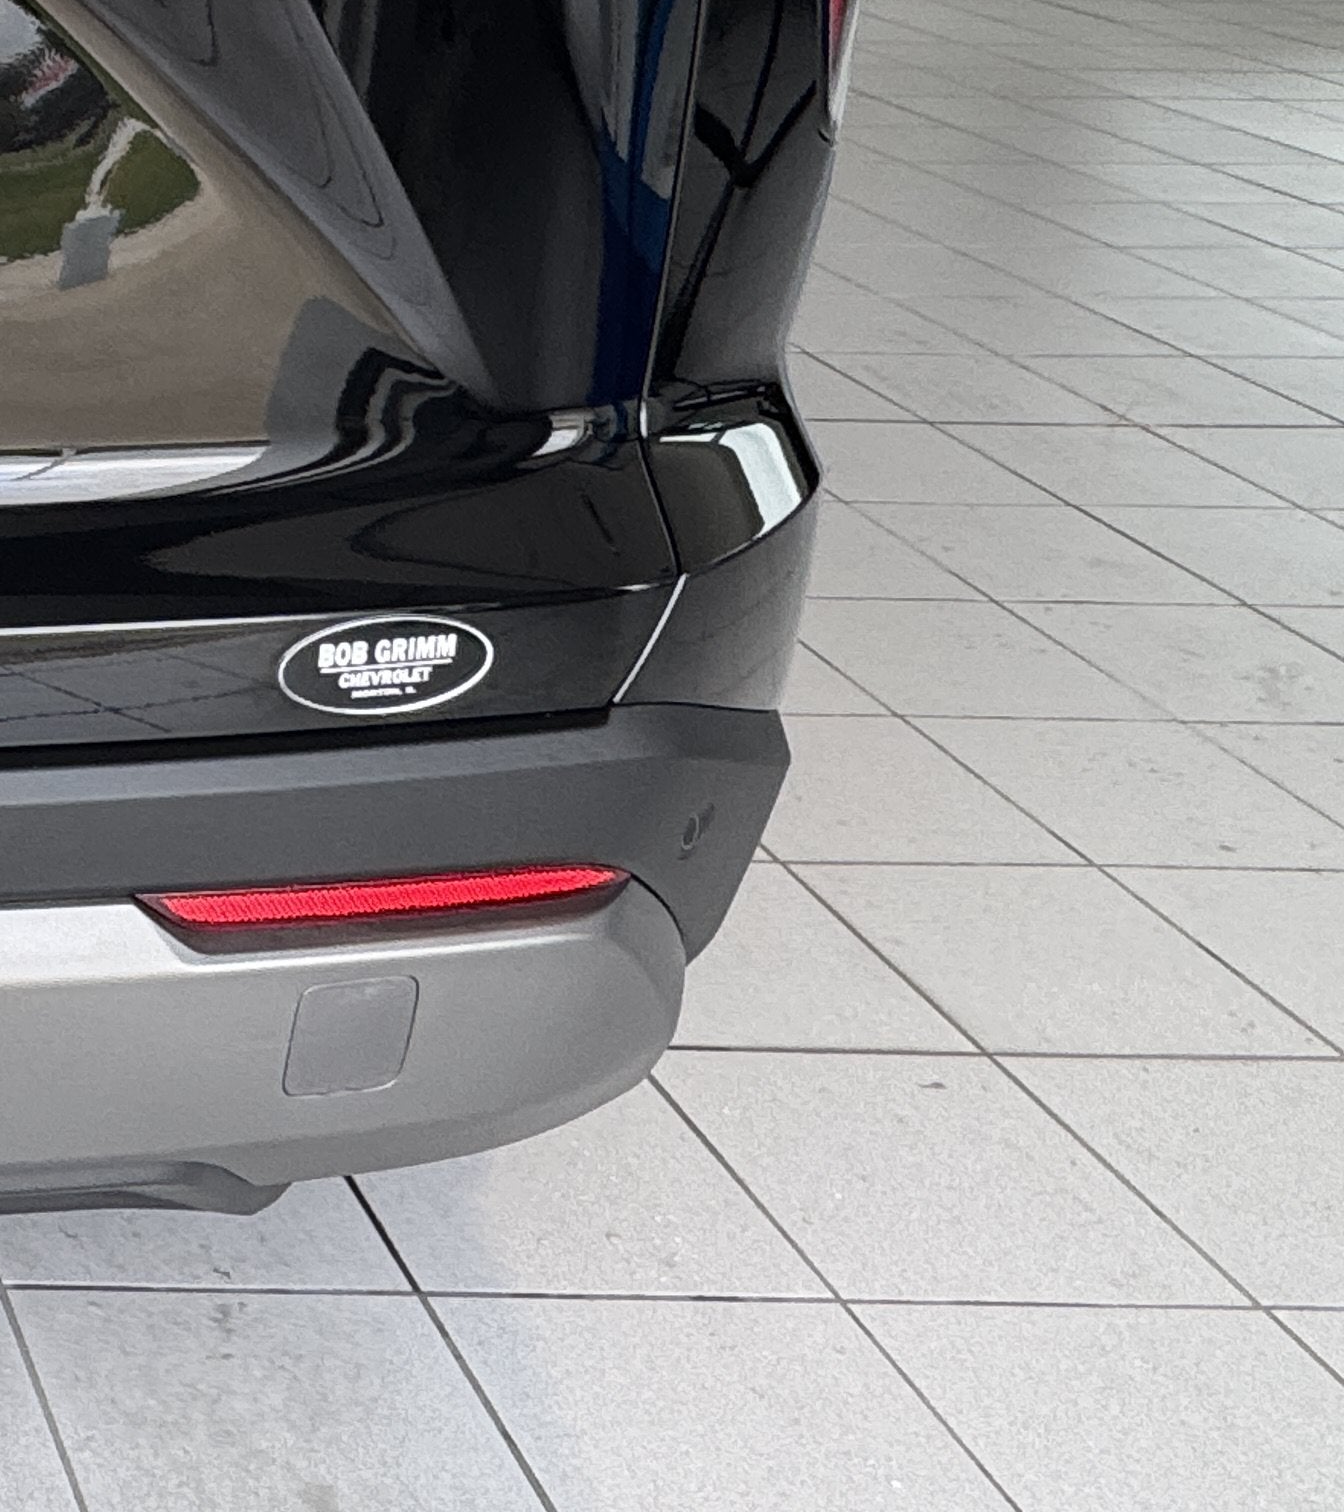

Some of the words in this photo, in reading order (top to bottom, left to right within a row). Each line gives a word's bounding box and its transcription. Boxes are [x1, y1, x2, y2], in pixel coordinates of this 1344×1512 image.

[318, 641, 369, 668] BOB
[374, 633, 458, 663] GRIMM
[338, 666, 433, 689] CHEVROLET
